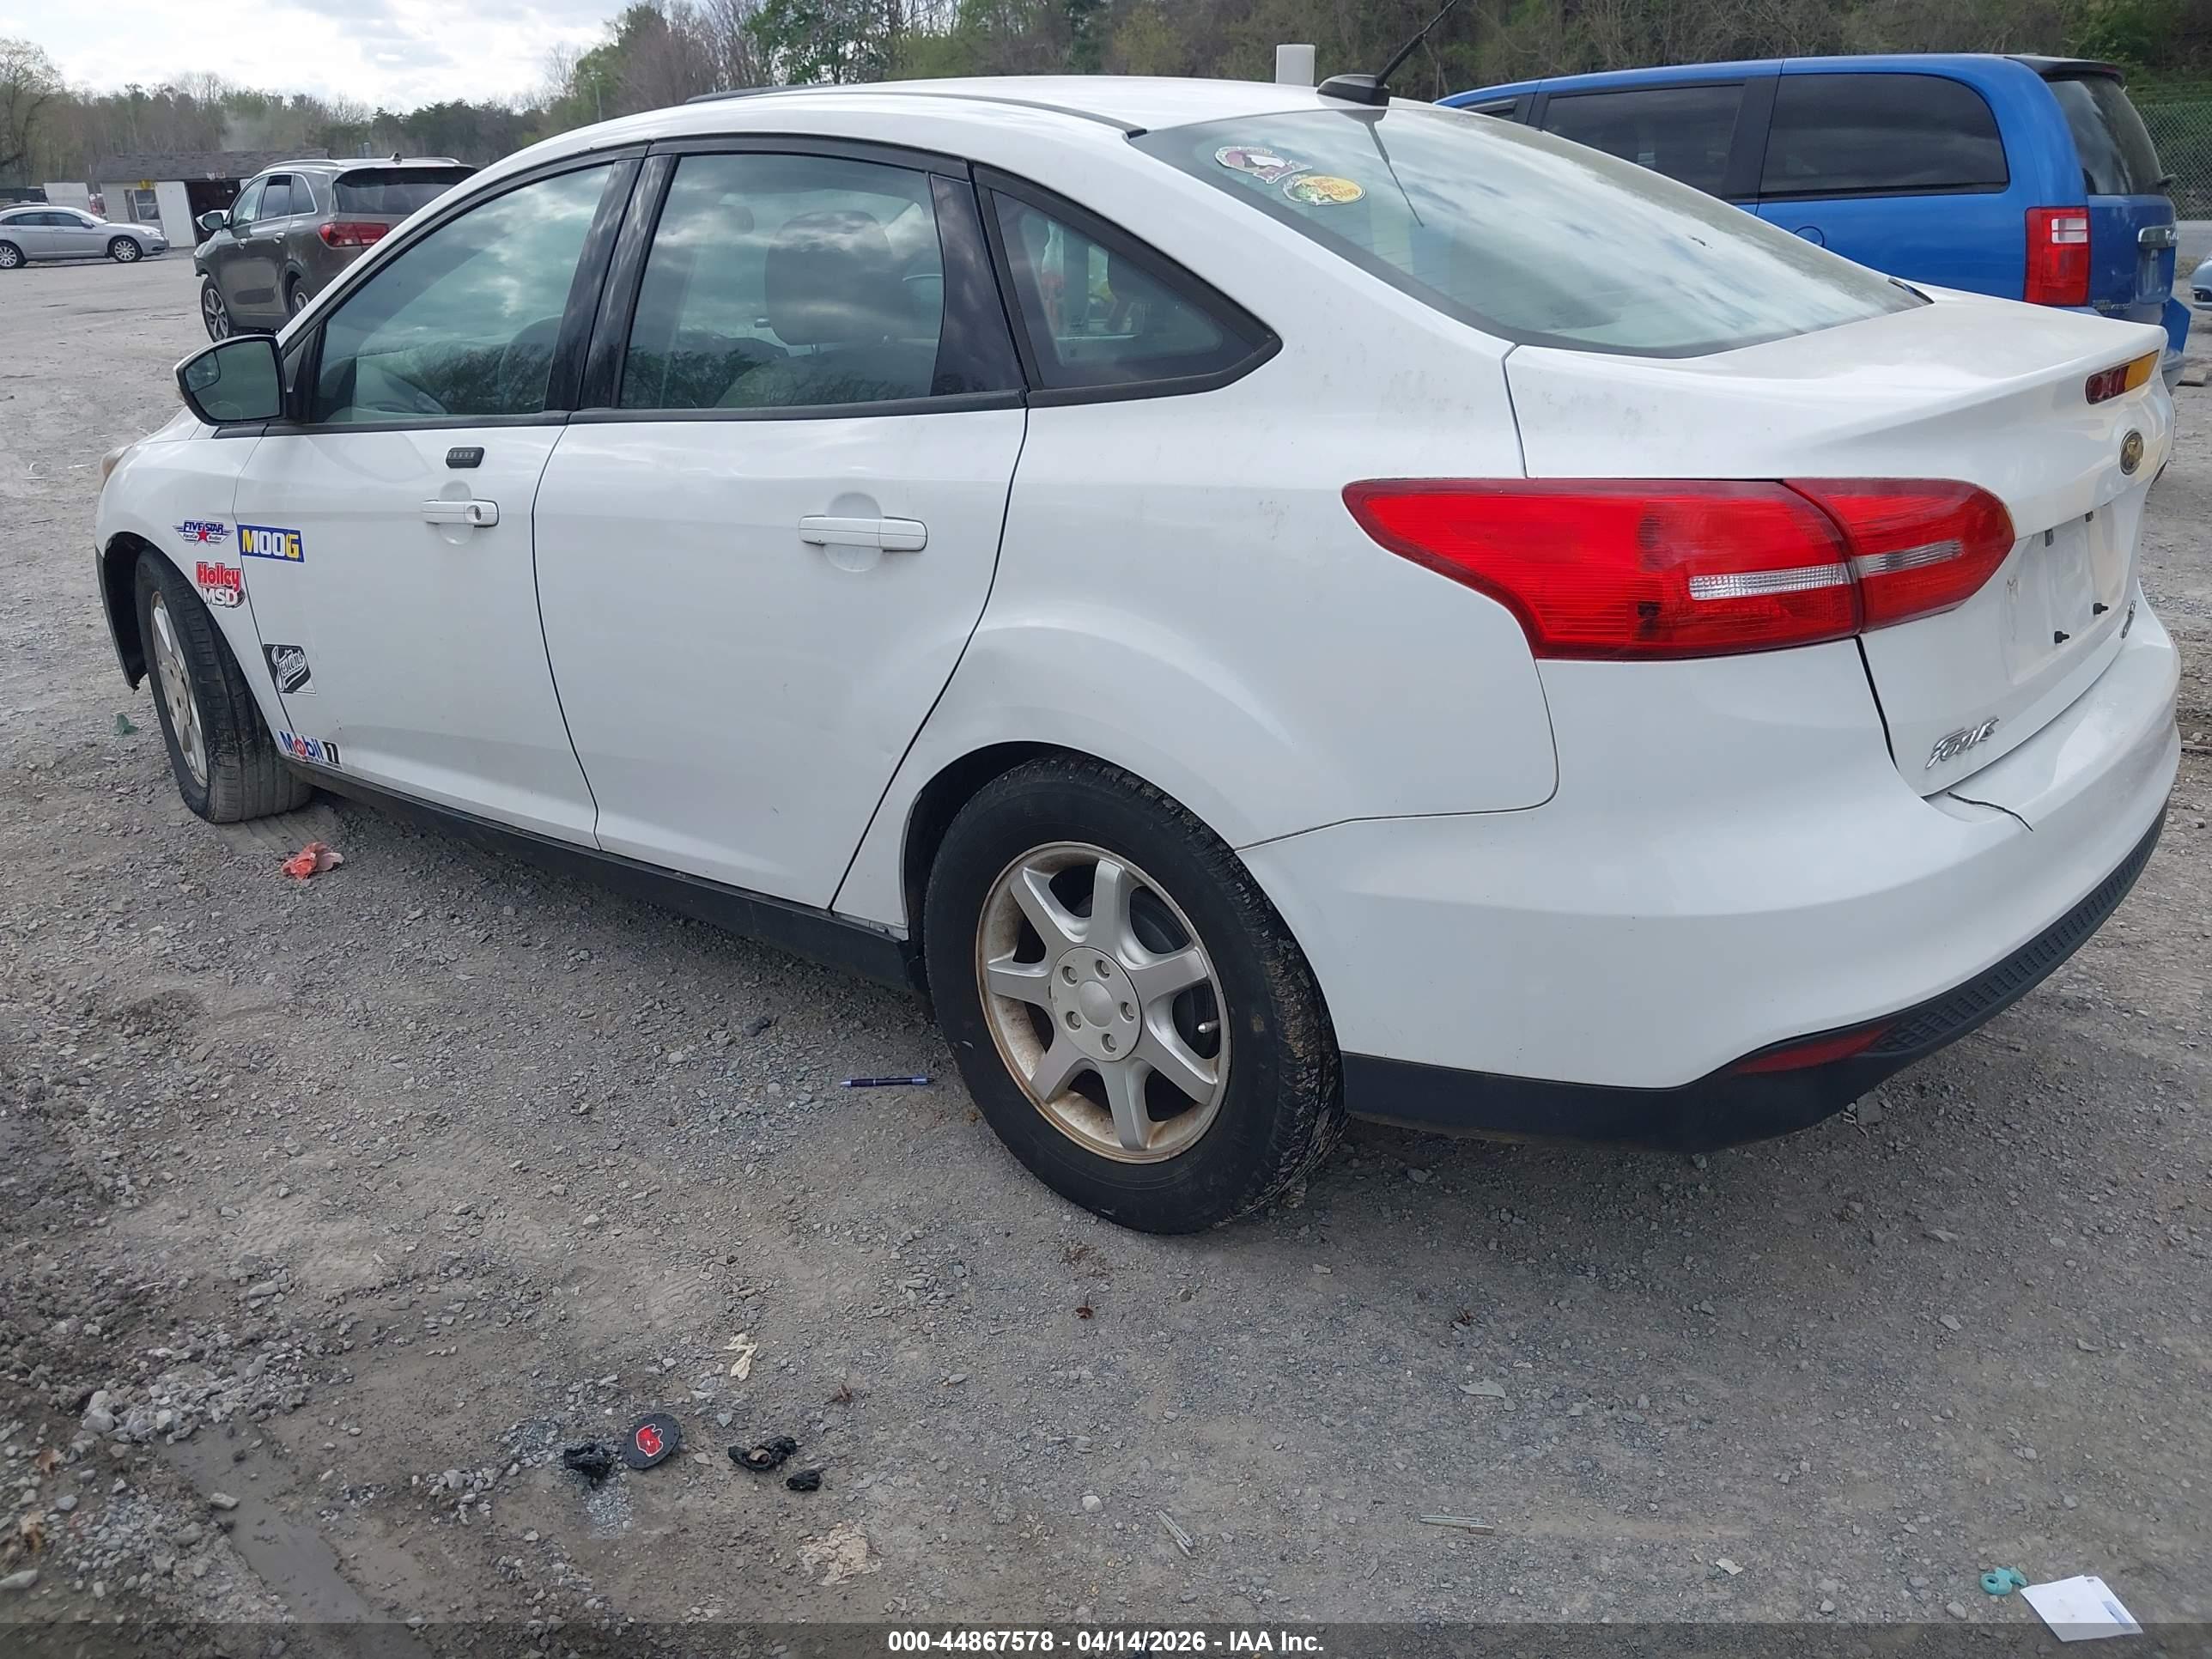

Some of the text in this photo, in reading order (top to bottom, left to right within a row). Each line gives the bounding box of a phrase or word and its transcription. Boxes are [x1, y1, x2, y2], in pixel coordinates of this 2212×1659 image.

[183, 521, 224, 534] FIVE STAR
[241, 529, 301, 559] MOOG
[196, 561, 241, 592] Holley
[202, 586, 240, 607] MSD
[279, 730, 325, 761] Mobil
